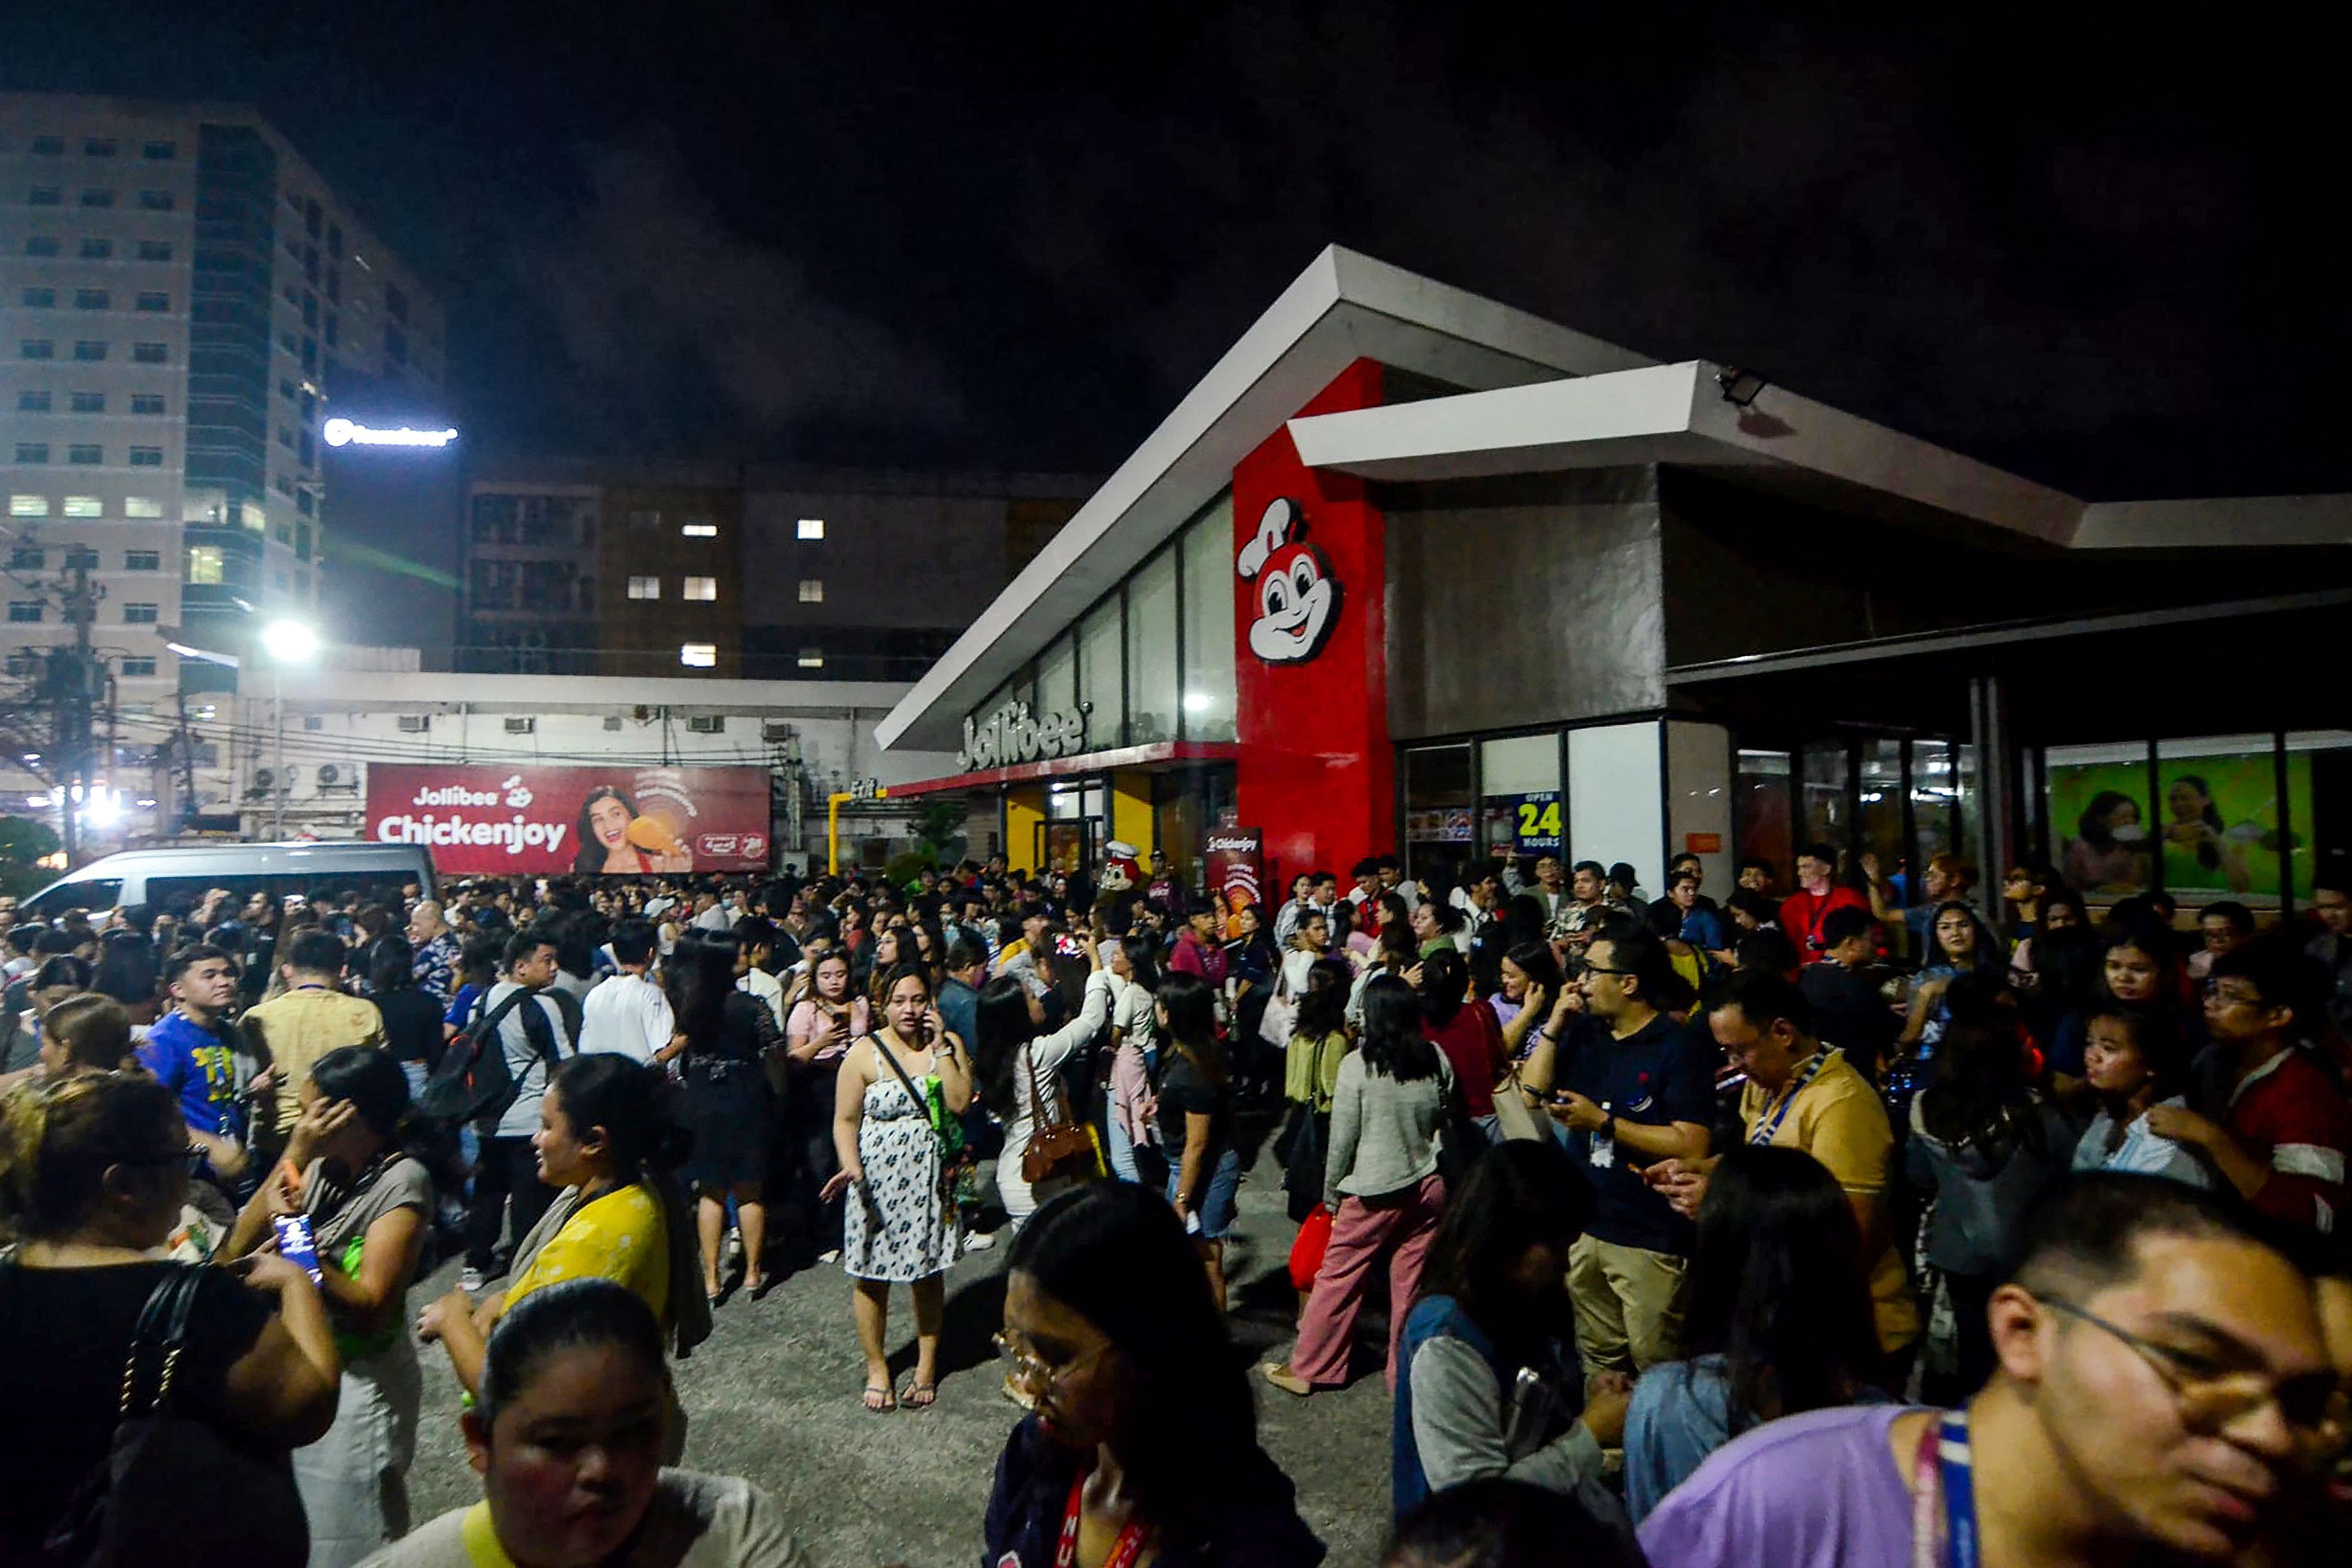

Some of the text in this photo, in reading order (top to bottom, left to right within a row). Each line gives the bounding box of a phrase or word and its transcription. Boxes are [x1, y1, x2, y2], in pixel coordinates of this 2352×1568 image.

[413, 785, 498, 806] Jollibee
[1526, 792, 1553, 802] OPEN
[1519, 802, 1561, 836] 24
[377, 814, 566, 854] Chickenjoy
[1523, 838, 1559, 847] HOURS
